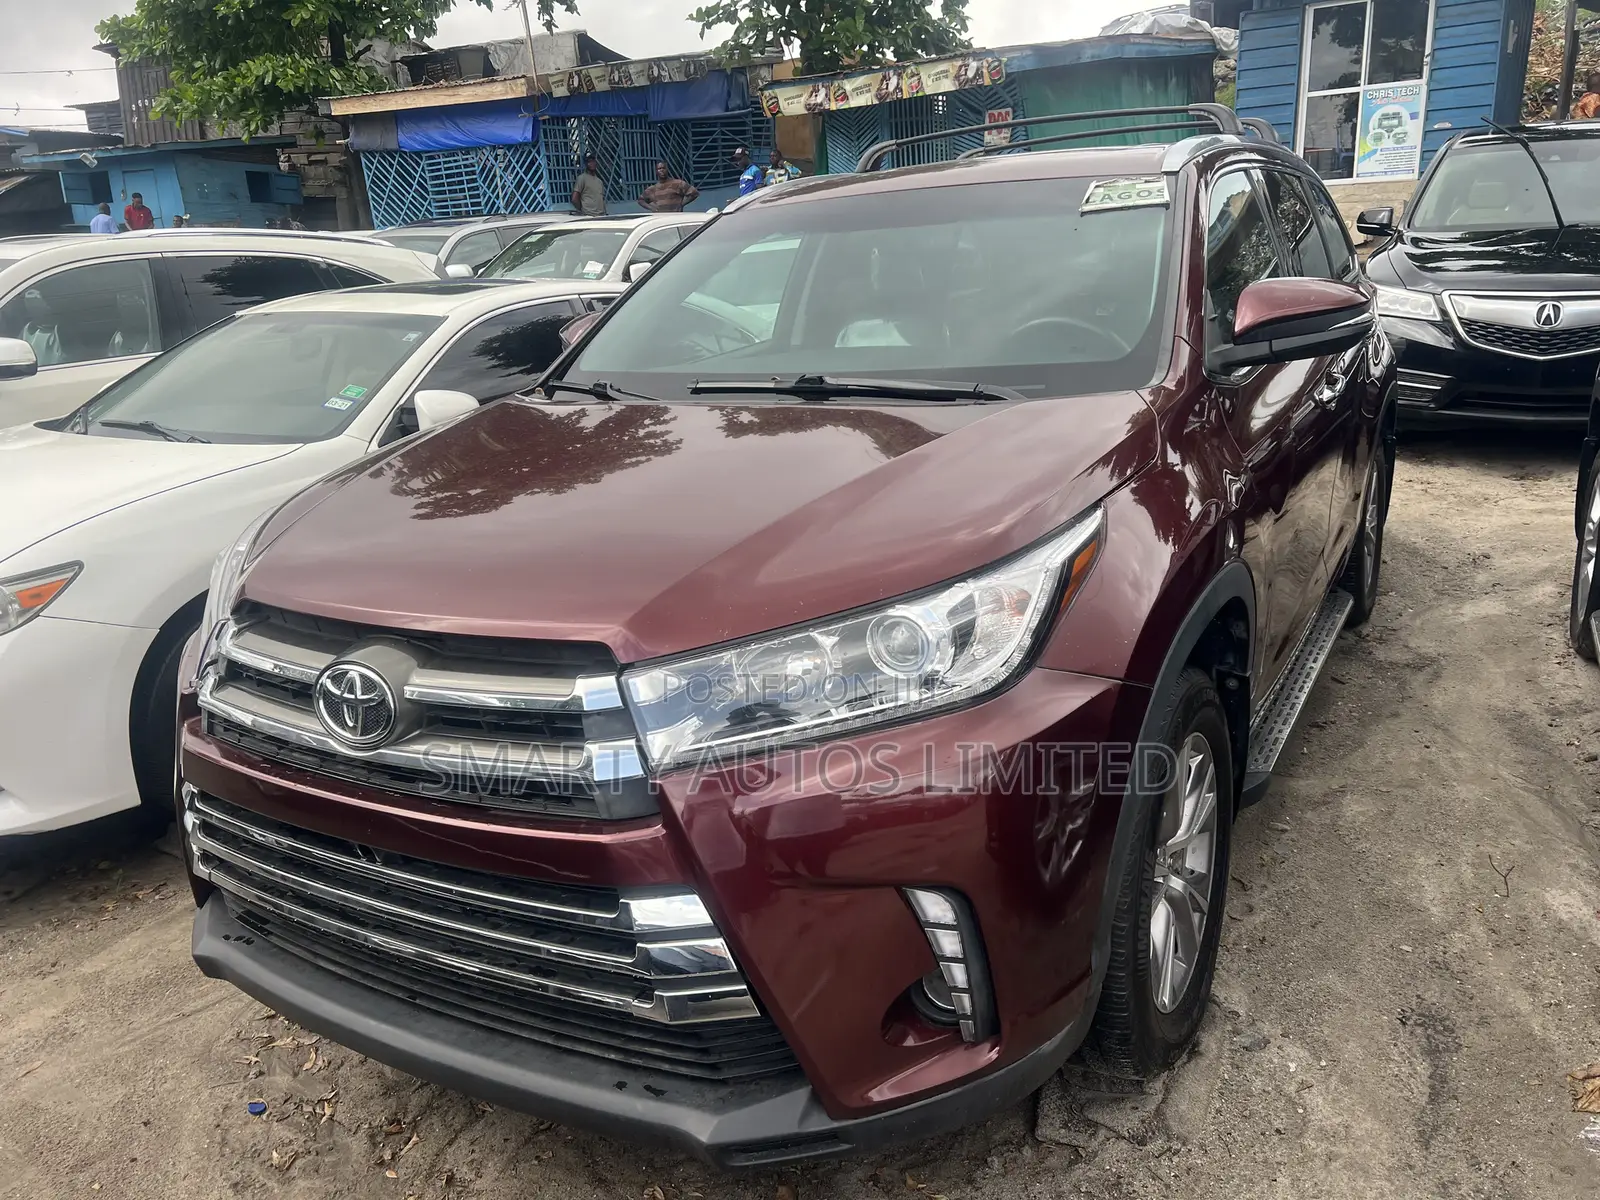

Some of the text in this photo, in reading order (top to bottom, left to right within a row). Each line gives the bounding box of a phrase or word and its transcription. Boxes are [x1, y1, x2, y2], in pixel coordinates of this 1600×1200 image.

[1366, 89, 1394, 100] CHRIS
[1397, 86, 1420, 97] TECH
[1088, 188, 1165, 203] AGOS
